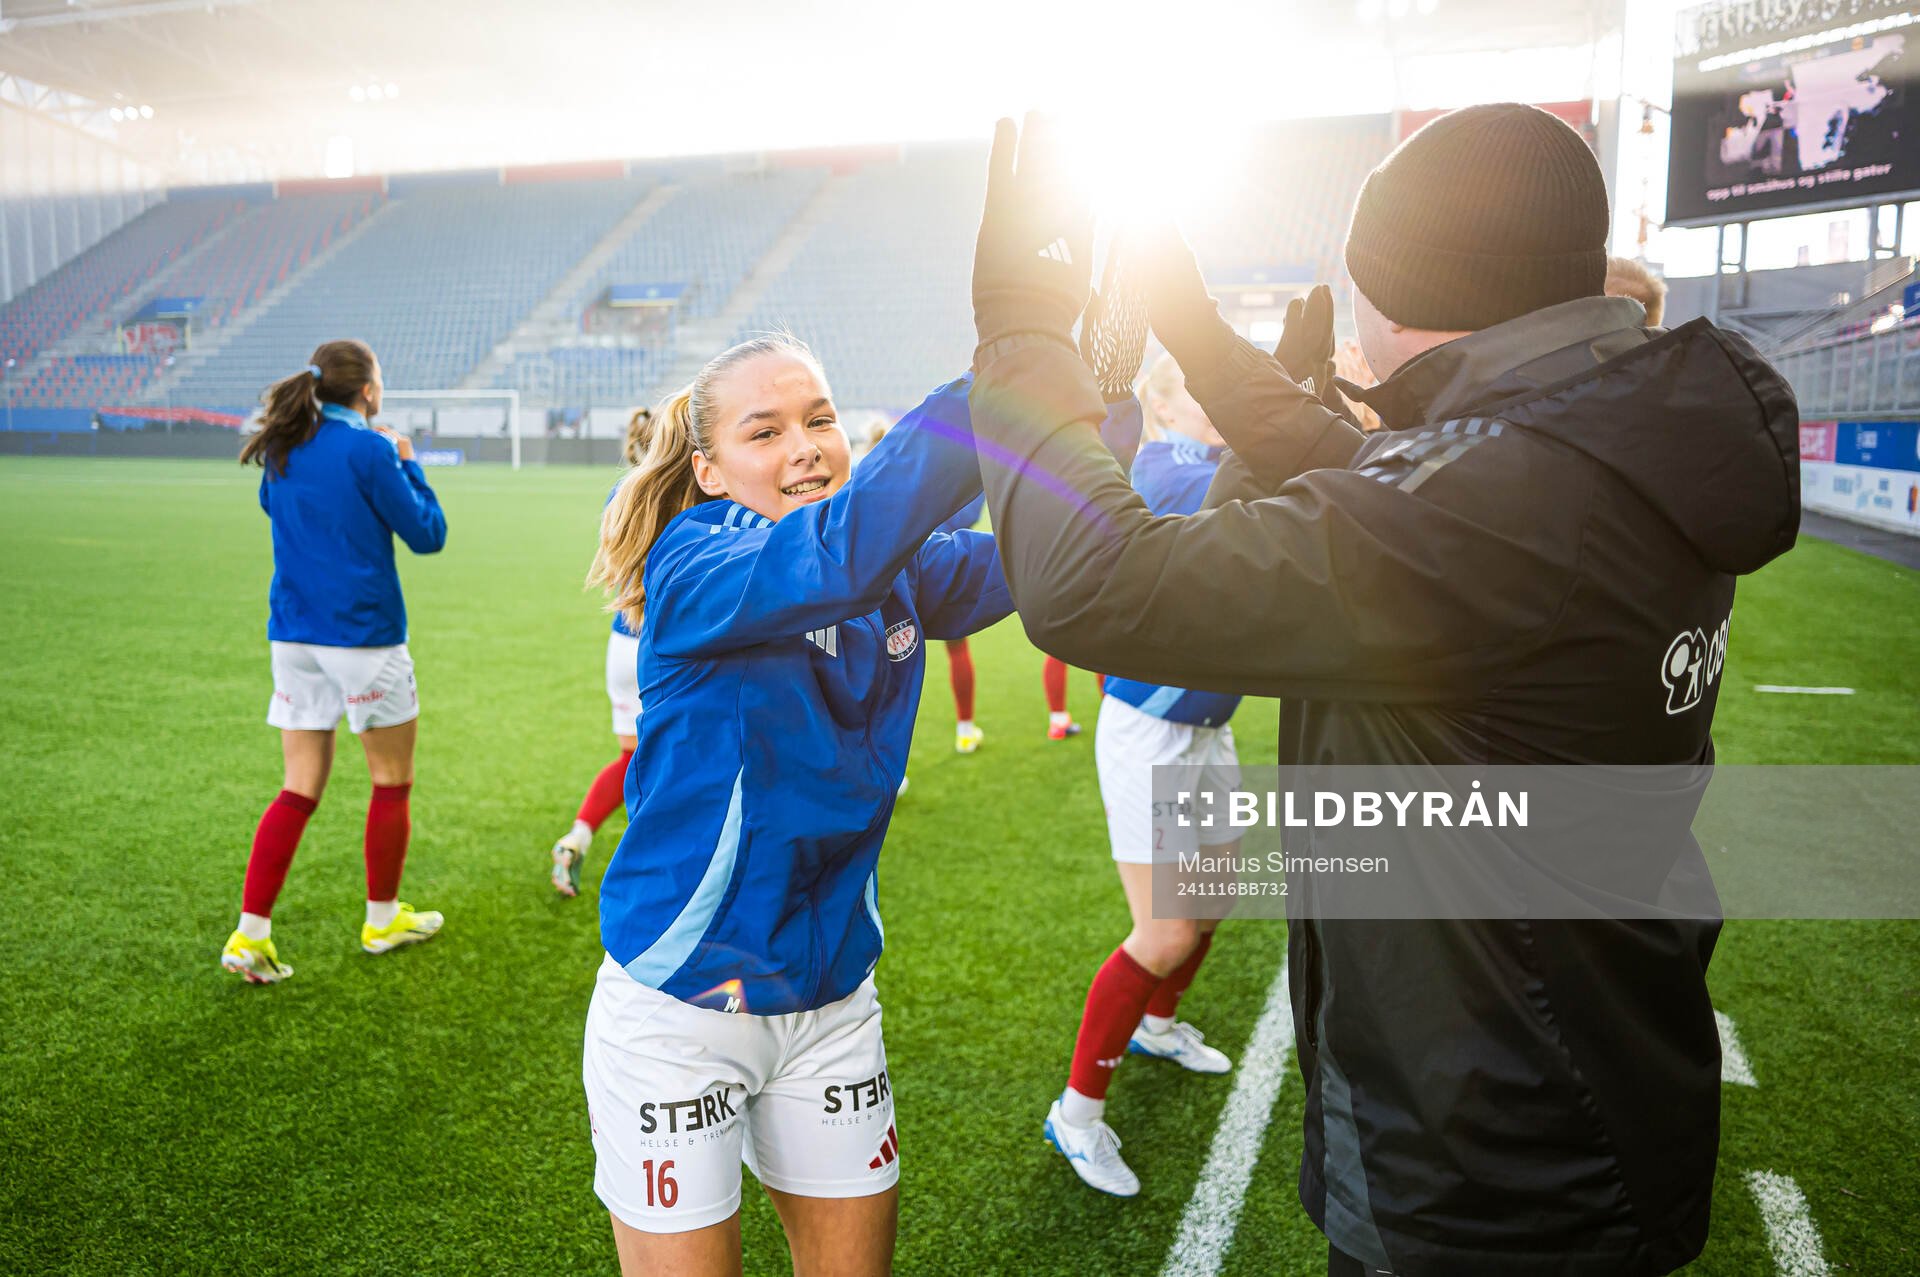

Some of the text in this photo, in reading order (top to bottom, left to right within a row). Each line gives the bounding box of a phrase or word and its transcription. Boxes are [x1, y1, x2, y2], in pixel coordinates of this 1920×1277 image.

[1707, 609, 1732, 685] OB
[1155, 828, 1164, 850] 2
[640, 1087, 736, 1134] STERK
[824, 1071, 890, 1113] STER
[640, 1120, 737, 1148] HELSE & TREN
[822, 1116, 860, 1126] HELSE
[643, 1159, 678, 1208] 16
